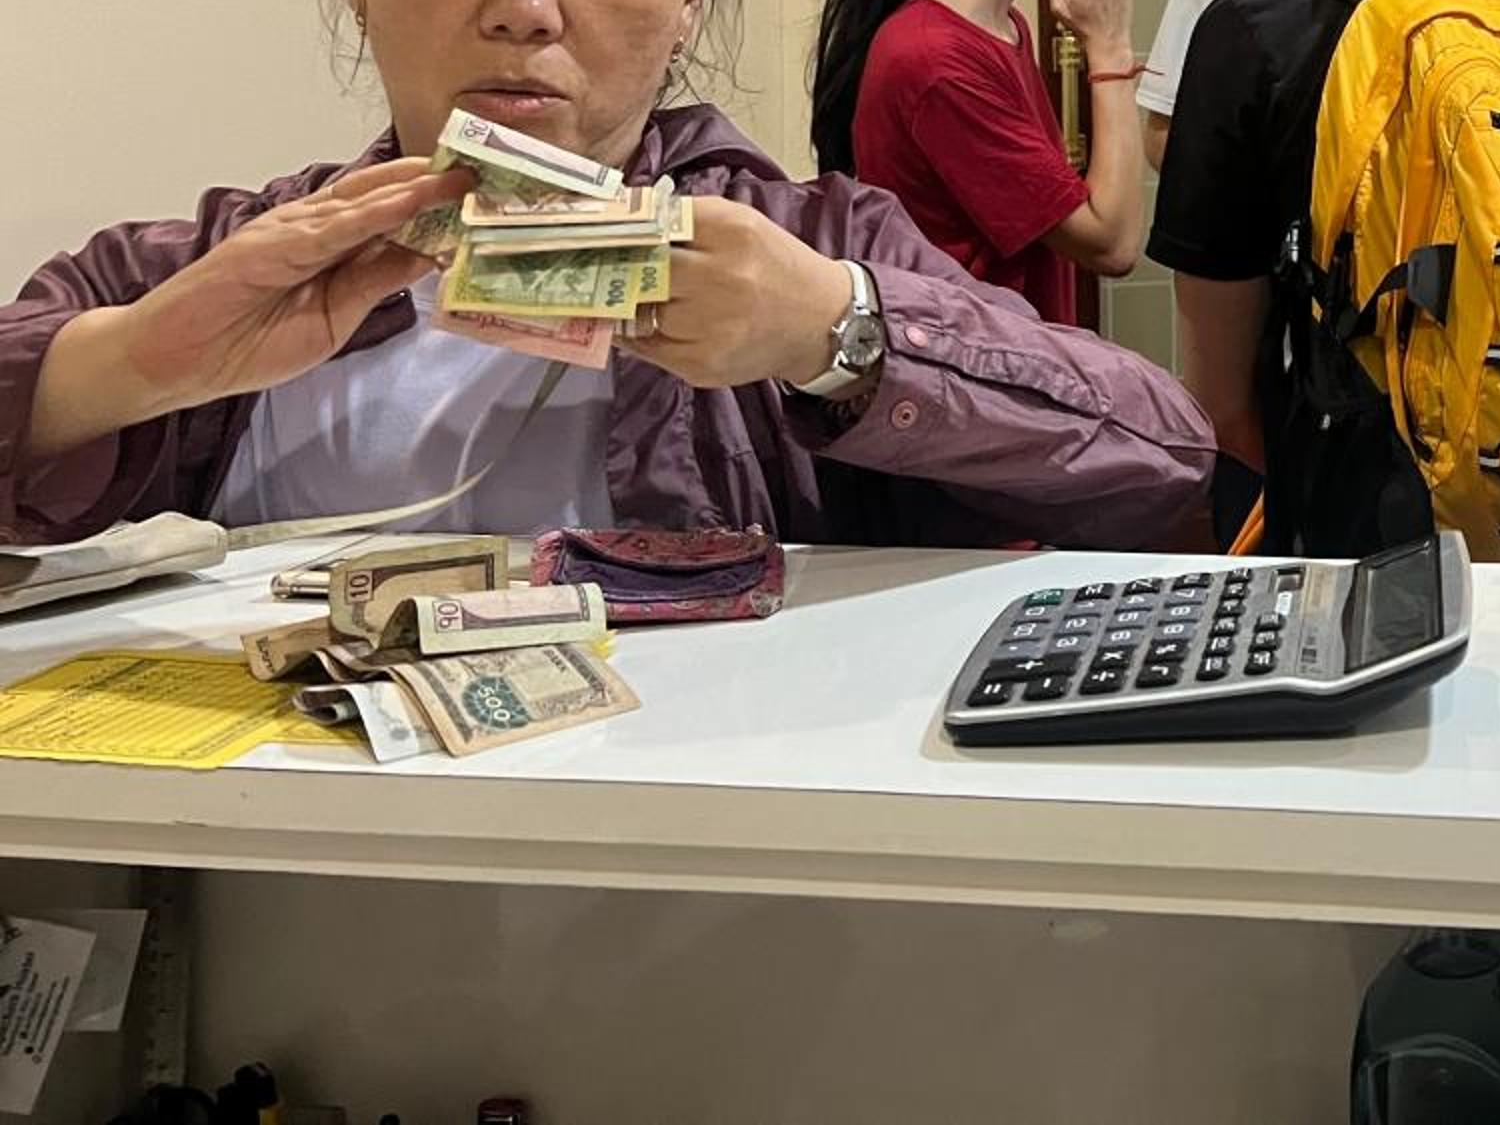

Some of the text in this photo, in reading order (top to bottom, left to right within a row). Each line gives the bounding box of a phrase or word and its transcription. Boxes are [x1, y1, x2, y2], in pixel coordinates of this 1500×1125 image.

[640, 266, 657, 292] 100
[606, 280, 625, 307] 100
[350, 574, 369, 600] 10
[479, 685, 512, 722] 500
